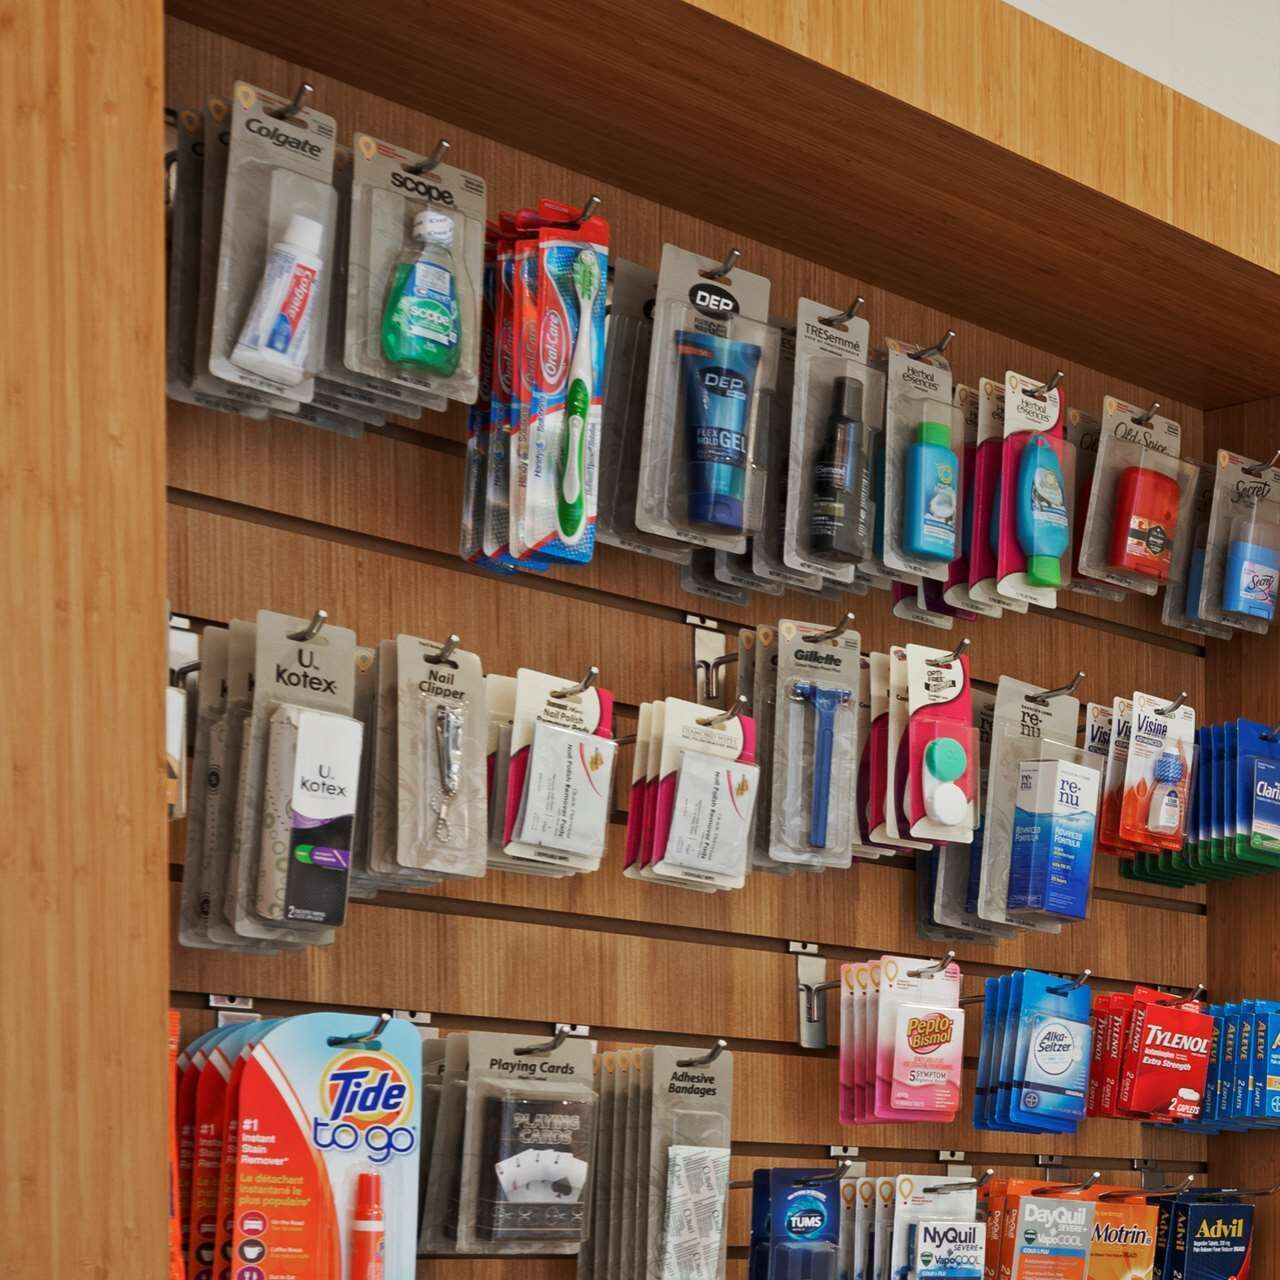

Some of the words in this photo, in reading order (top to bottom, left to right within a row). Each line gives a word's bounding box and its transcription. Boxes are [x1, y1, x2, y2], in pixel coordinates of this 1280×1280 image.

[246, 118, 321, 157] Colgate
[391, 171, 454, 205] scope
[285, 267, 317, 320] Colgate
[695, 289, 734, 312] DEP
[409, 304, 450, 326] scope
[804, 322, 861, 351] TRESemmé
[704, 372, 744, 390] DEP
[902, 374, 940, 392] essences
[906, 366, 935, 383] Herbal
[1113, 421, 1139, 443] Old
[1142, 431, 1168, 454] Spice
[1231, 480, 1271, 500] Secret
[793, 648, 843, 667] Gillette
[275, 664, 337, 695] kotex
[428, 669, 455, 685] Nail
[418, 680, 465, 700] Clipper
[543, 708, 560, 720] Nail
[560, 712, 584, 724] Polish
[300, 775, 347, 798] kotex
[912, 1030, 952, 1049] Bismol
[1042, 1031, 1067, 1042] Alka-
[1131, 1009, 1145, 1054] TYLENOL
[1145, 1024, 1209, 1054] TYLENOL
[1037, 1041, 1072, 1053] Seltzer
[489, 1058, 537, 1075] Playing
[540, 1061, 575, 1075] Cards
[670, 1071, 715, 1085] Adhesive
[327, 1069, 407, 1121] Tide
[668, 1083, 717, 1097] Bandages
[242, 1118, 259, 1131] #1
[513, 1112, 580, 1130] PLAYING
[241, 1133, 276, 1143] Instant
[313, 1116, 358, 1150] to
[364, 1125, 415, 1162] go
[519, 1129, 573, 1144] CARDS
[791, 1215, 822, 1229] TUMS
[1024, 1204, 1087, 1227] DayQuil
[923, 1227, 976, 1248] NyQuil
[1091, 1224, 1147, 1244] Motrin
[1195, 1218, 1245, 1238] Advil
[935, 1255, 981, 1265] VapoCOOL
